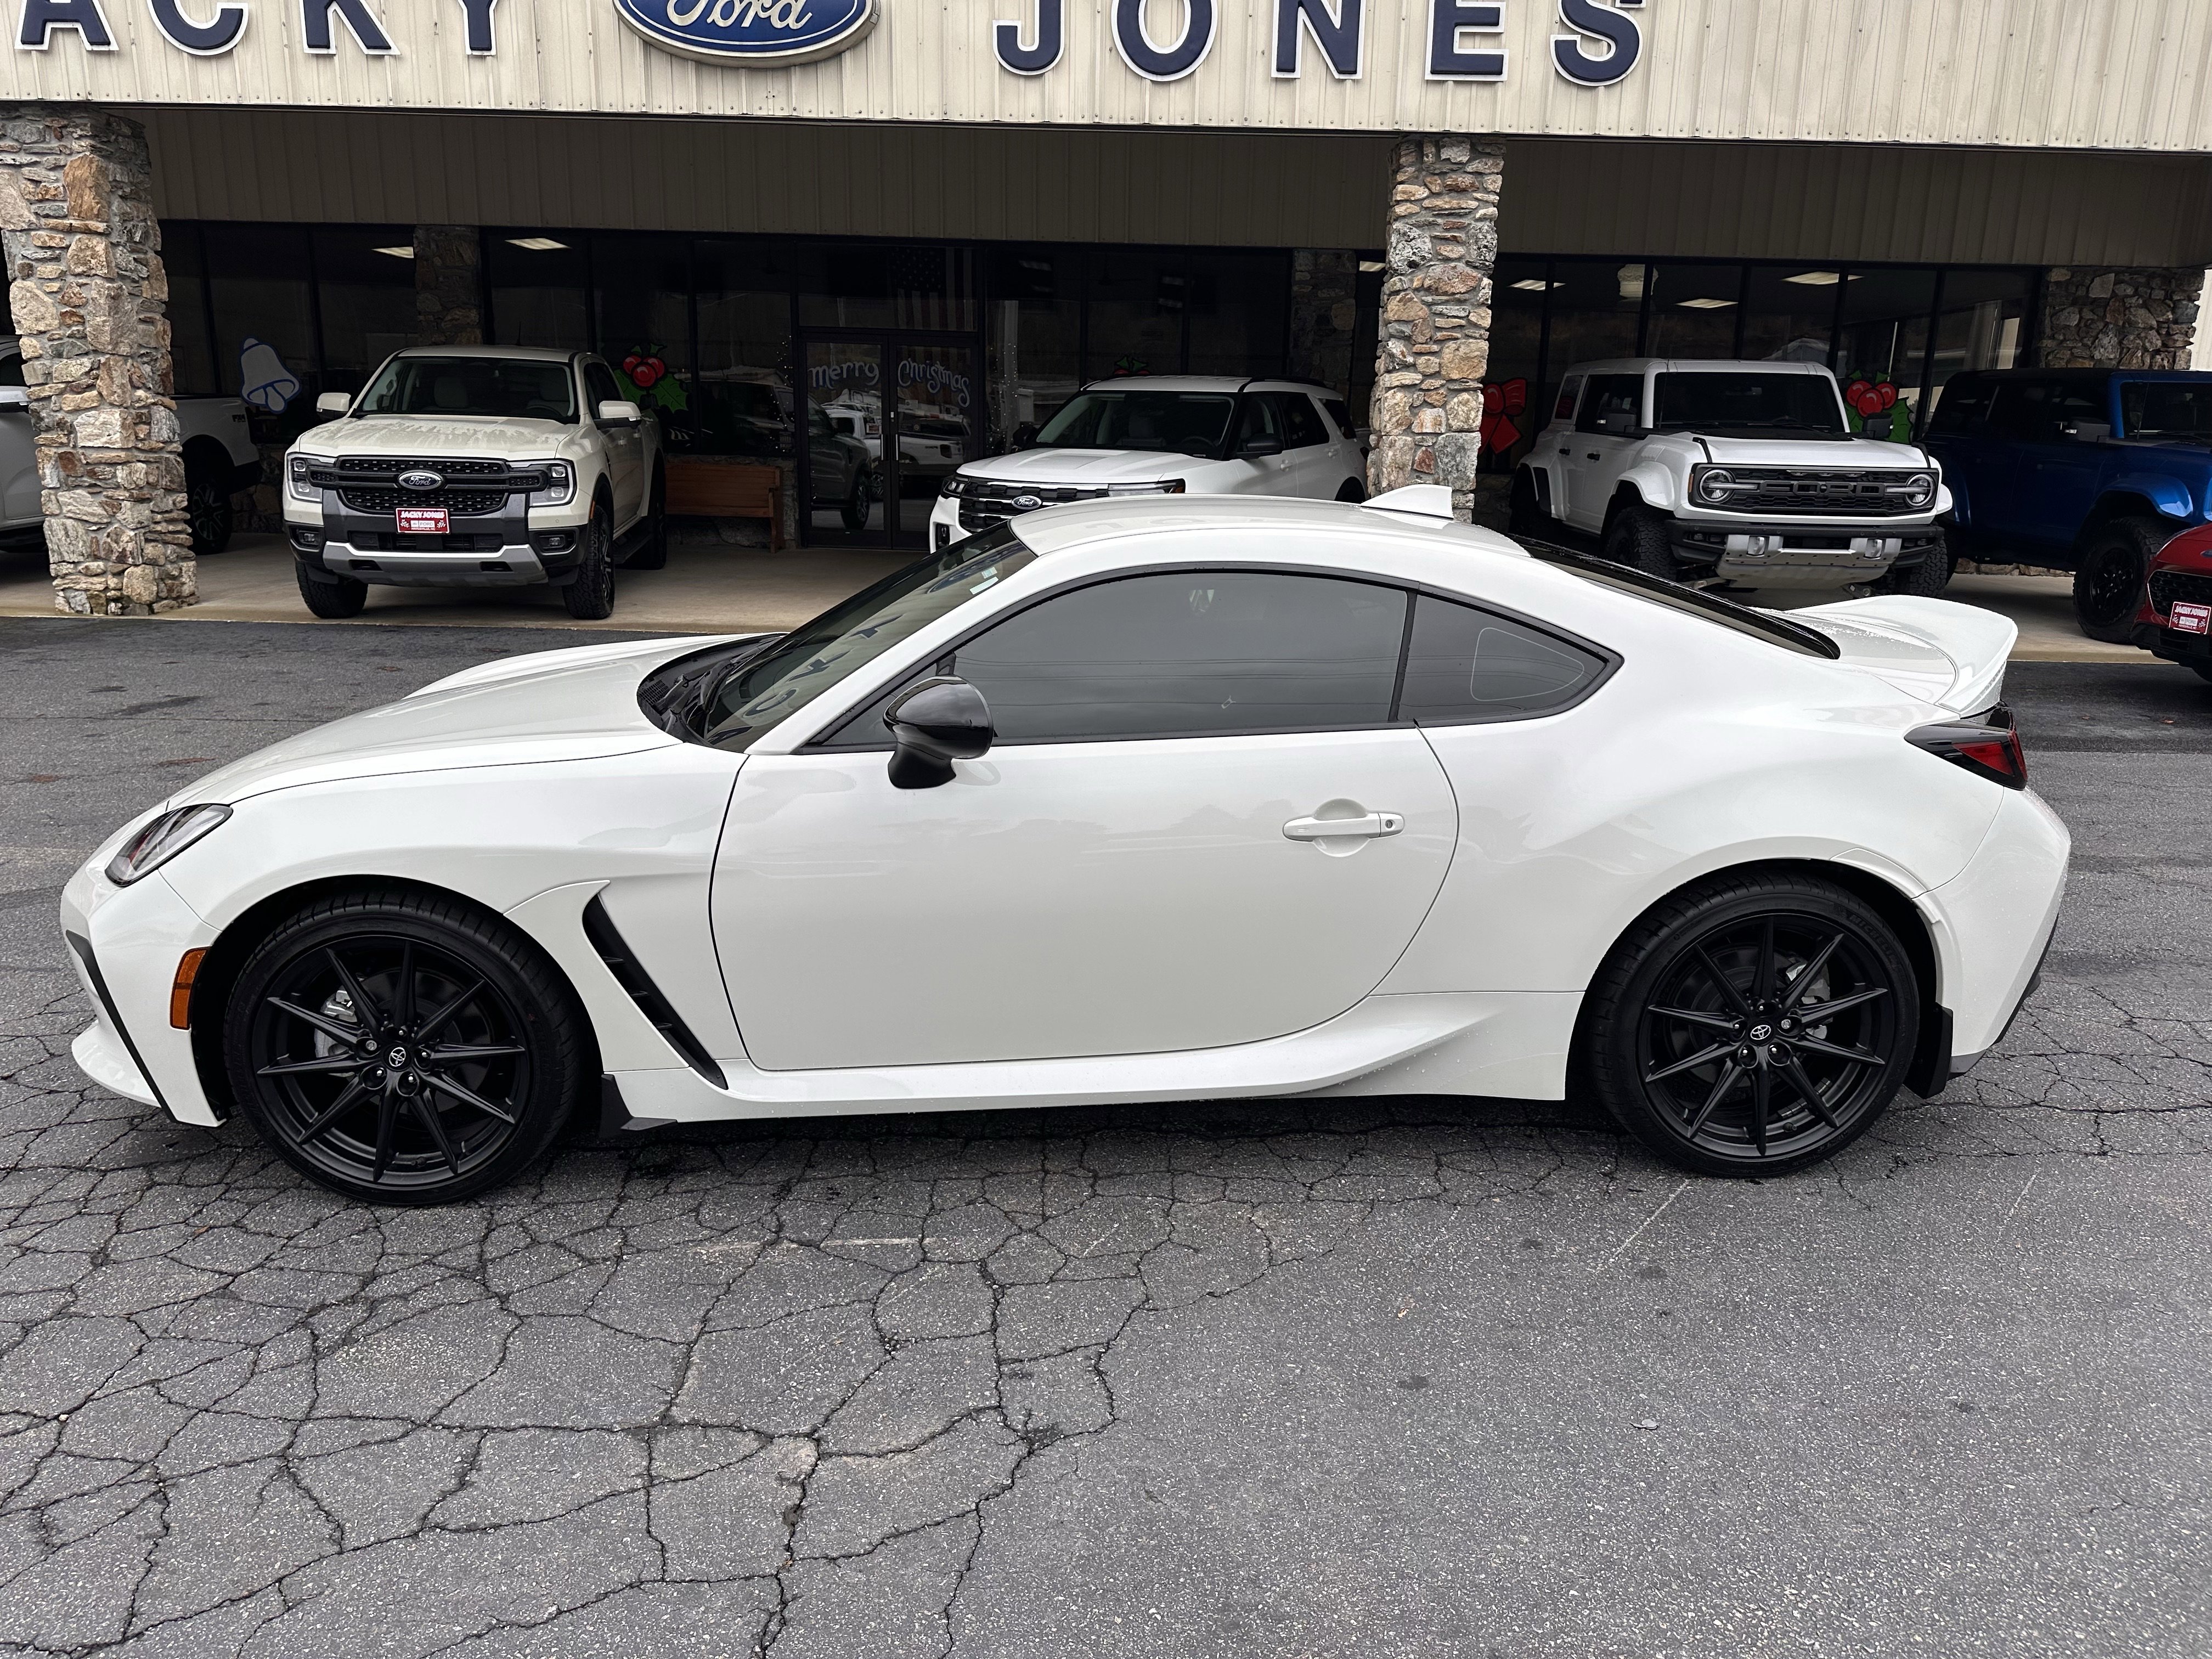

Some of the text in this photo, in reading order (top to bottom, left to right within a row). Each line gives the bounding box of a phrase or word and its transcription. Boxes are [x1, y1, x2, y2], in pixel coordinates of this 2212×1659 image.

[993, 0, 1642, 86] JONES
[898, 358, 970, 408] Christmas
[409, 476, 431, 485] Ford
[1759, 480, 1886, 498] FORD
[1017, 498, 1034, 506] Ford
